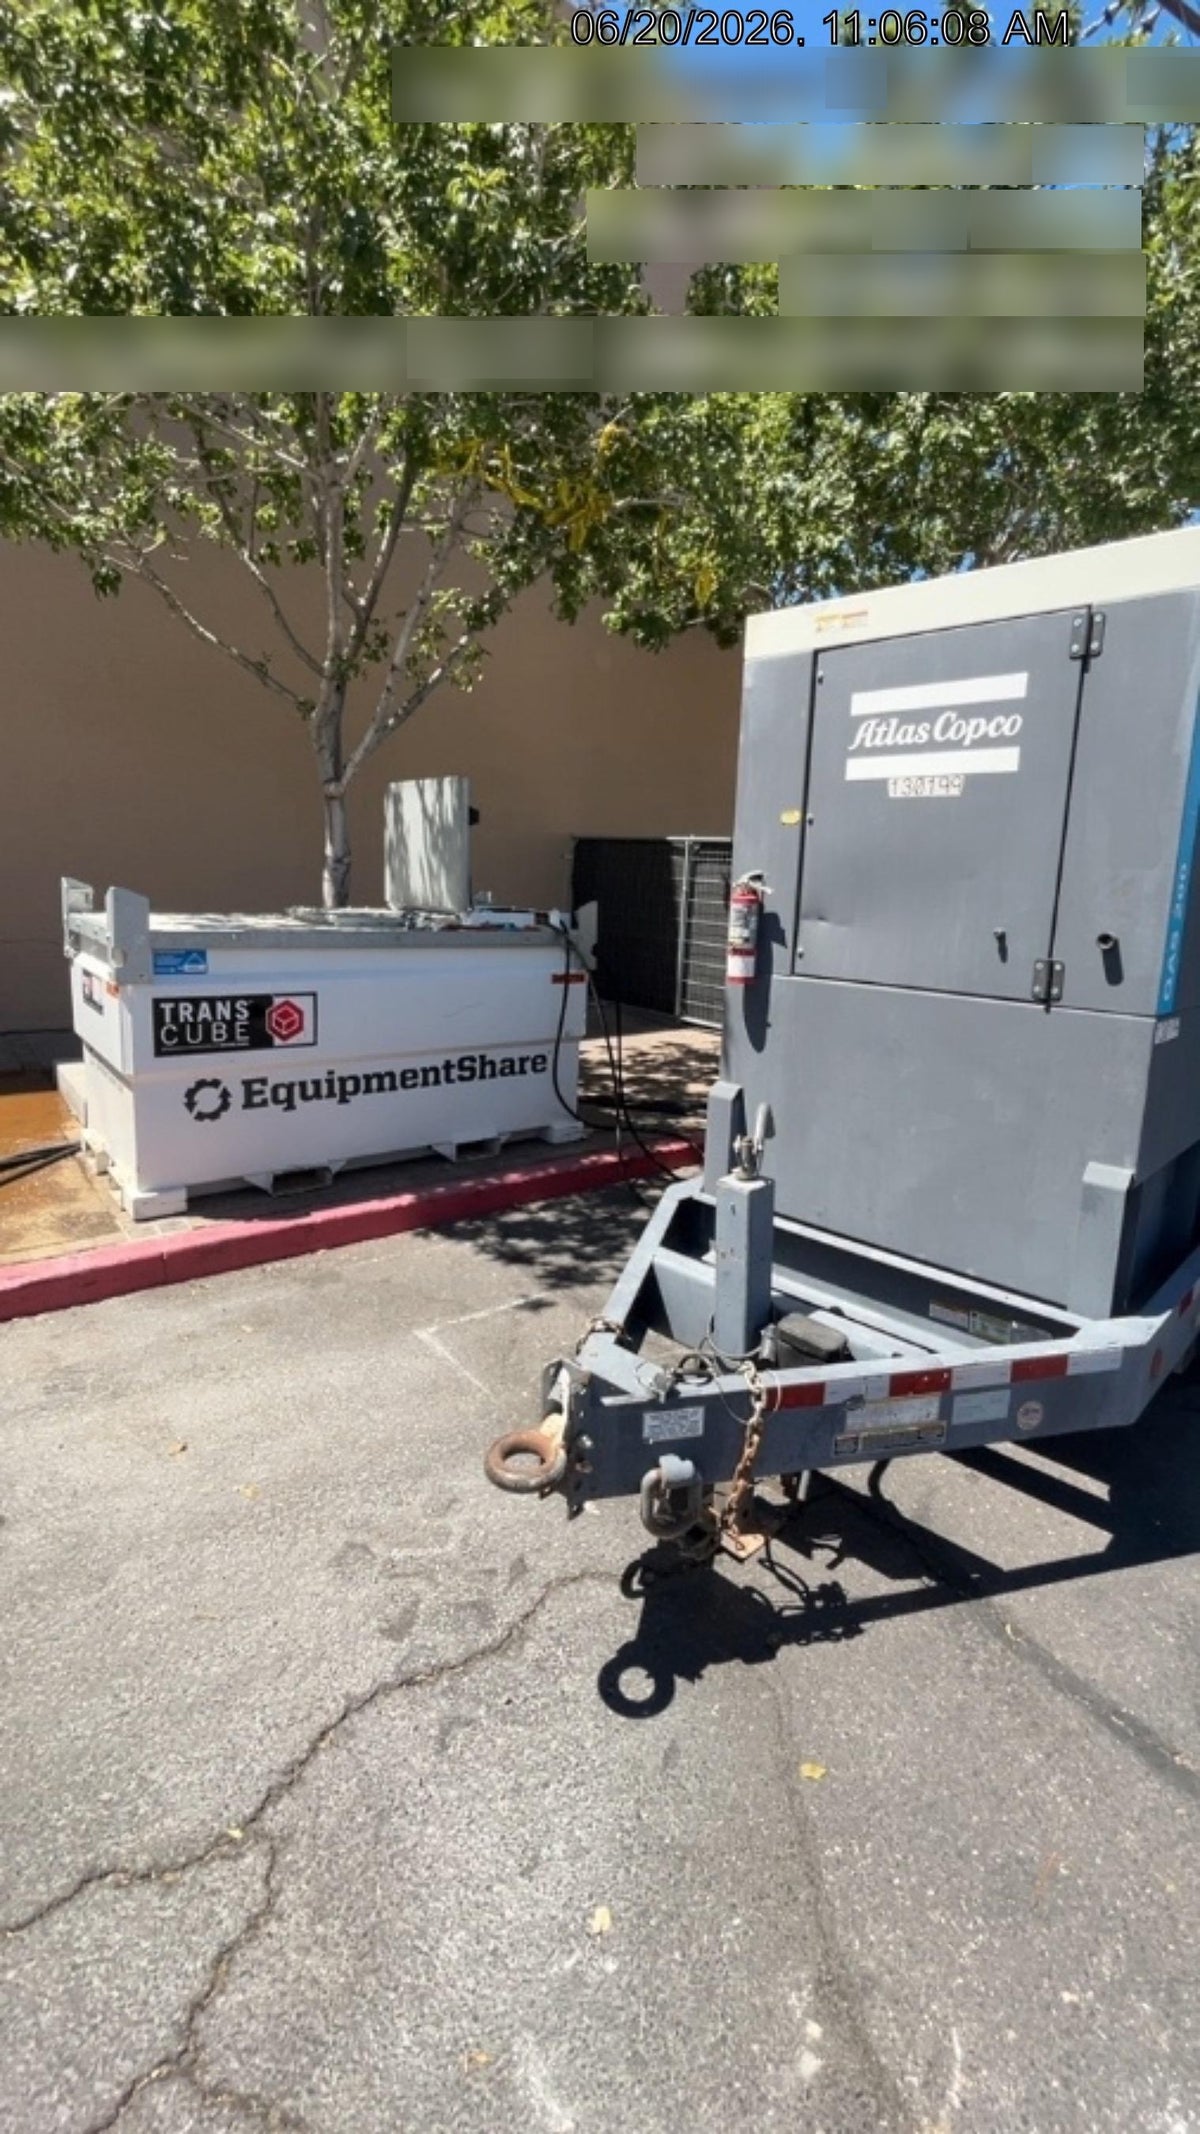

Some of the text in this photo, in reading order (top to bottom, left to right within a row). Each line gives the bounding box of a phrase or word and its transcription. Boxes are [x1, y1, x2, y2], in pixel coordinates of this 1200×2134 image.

[847, 710, 1024, 751] Atlas Copco
[159, 1000, 250, 1024] TRANS
[160, 1021, 250, 1046] CUBE
[240, 1053, 548, 1112] EquipmentShare
